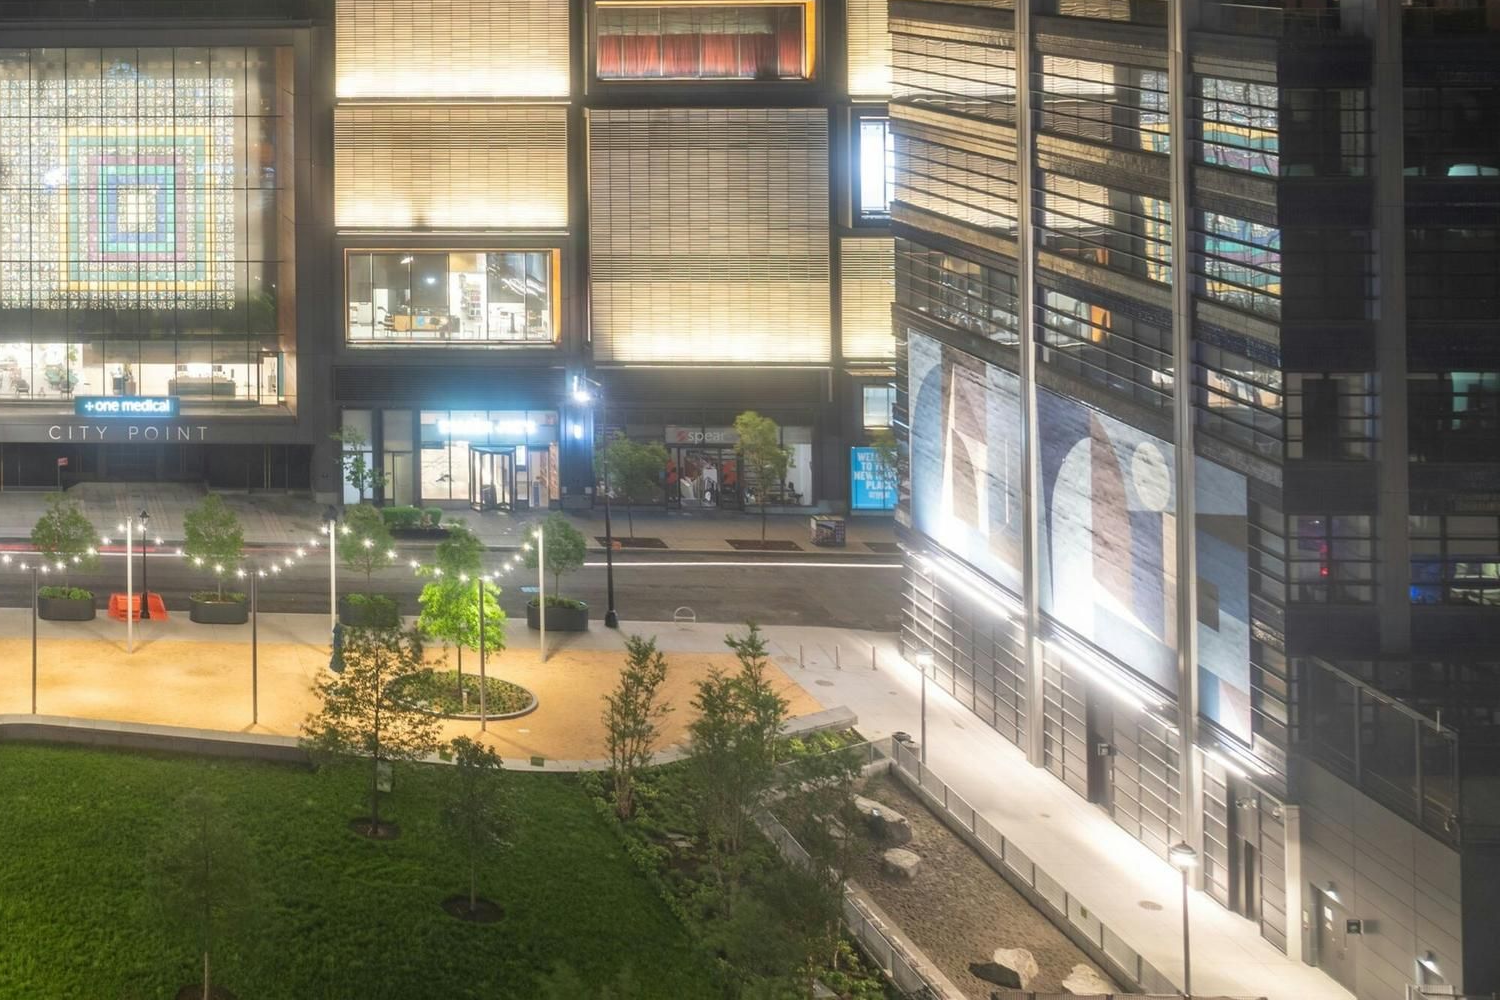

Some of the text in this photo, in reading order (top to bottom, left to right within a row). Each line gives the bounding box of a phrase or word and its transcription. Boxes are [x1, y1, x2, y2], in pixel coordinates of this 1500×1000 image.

[95, 399, 170, 412] one medical
[48, 425, 208, 441] CITY POINT
[687, 429, 725, 445] spear
